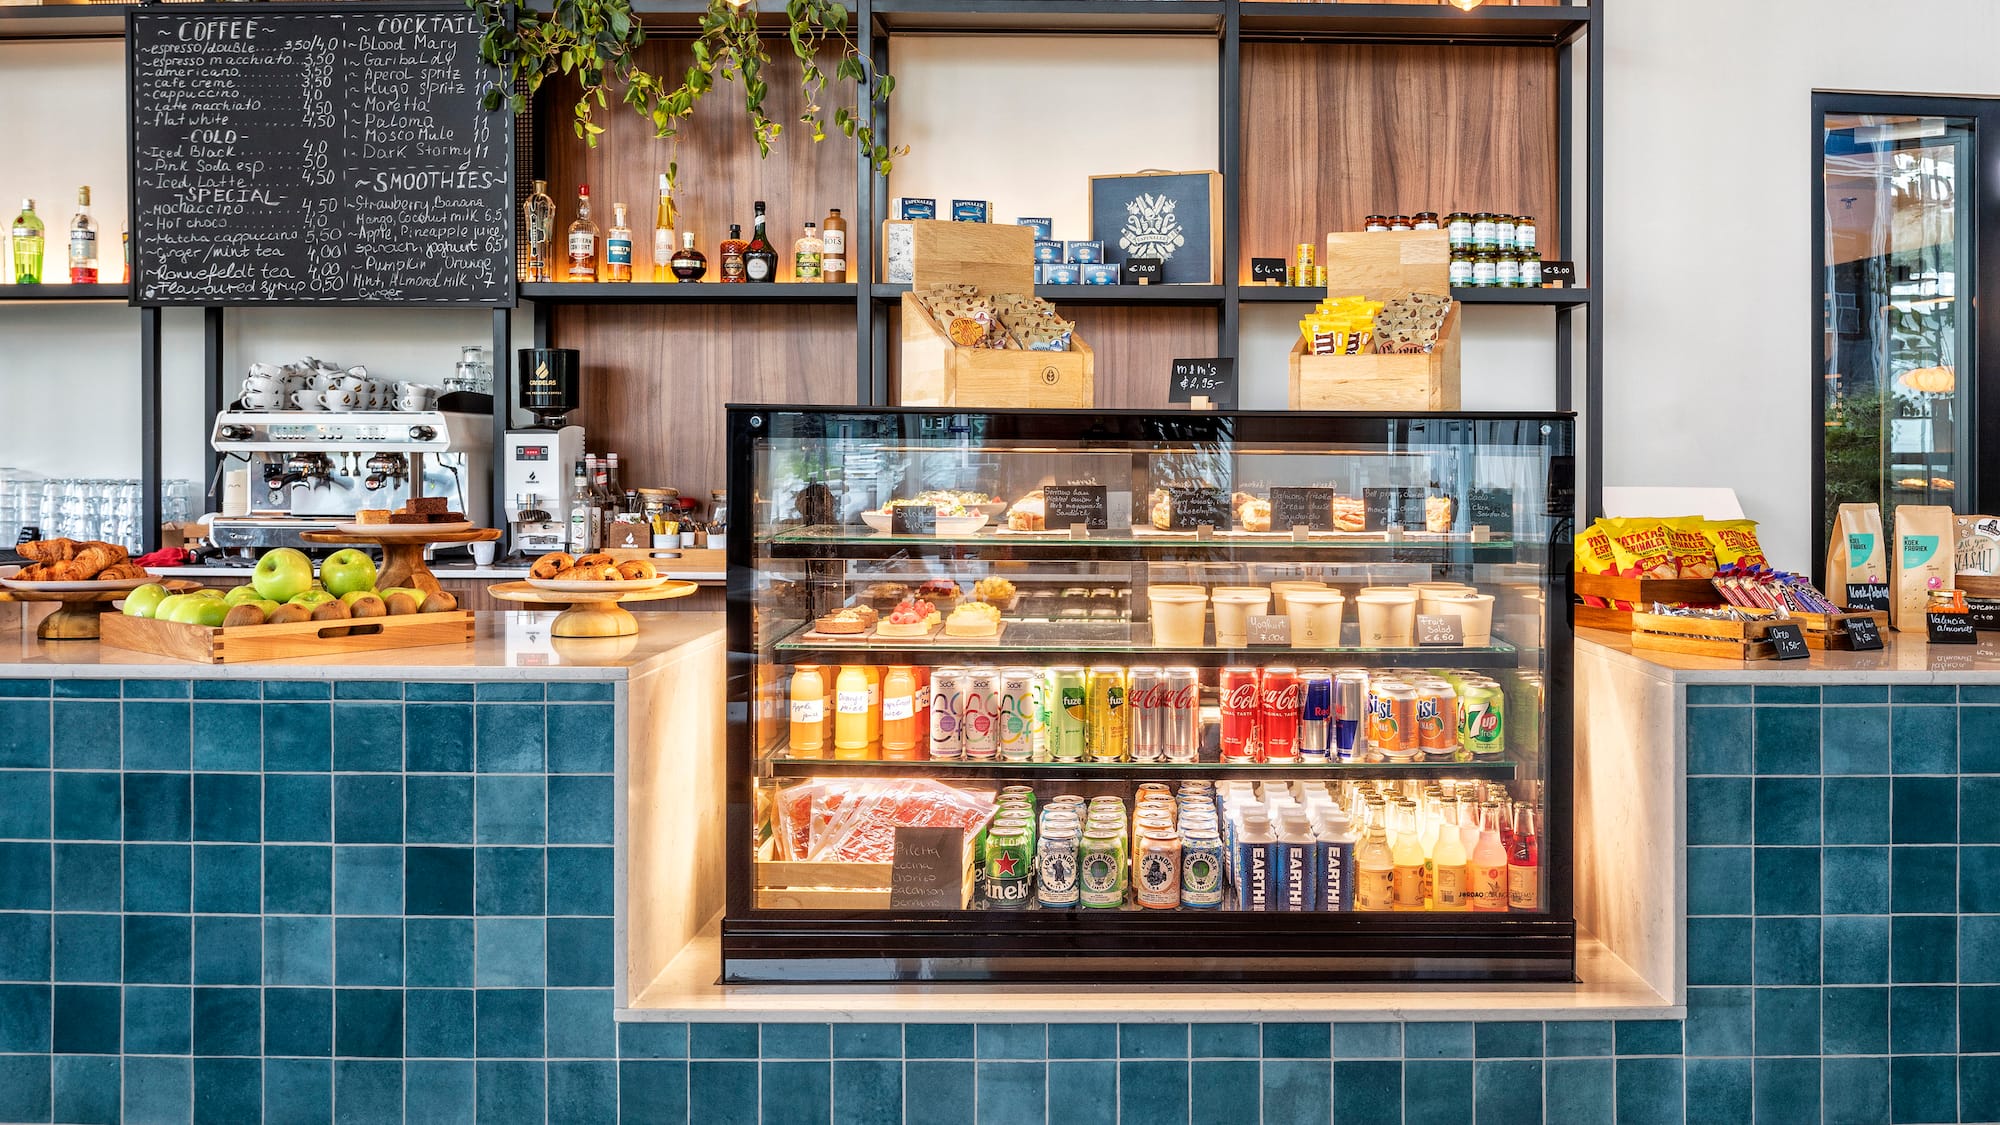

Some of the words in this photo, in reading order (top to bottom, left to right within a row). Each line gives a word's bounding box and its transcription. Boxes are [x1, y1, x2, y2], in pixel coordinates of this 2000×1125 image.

[179, 21, 258, 41] COFFEE
[151, 41, 254, 56] espresso/double
[283, 36, 338, 54] 3,50/4,0
[360, 35, 405, 51] Blood
[415, 35, 457, 61] Mary
[153, 57, 204, 68] espresso
[210, 54, 292, 65] macchiato
[304, 53, 335, 66] 3,50
[155, 68, 239, 77] americano
[302, 66, 332, 79] 3,50
[365, 68, 414, 84] Aperol
[421, 66, 461, 89] spritz
[475, 69, 487, 80] 11
[155, 79, 186, 88] cafe
[192, 79, 235, 87] creme
[302, 76, 331, 89] 3,50
[153, 90, 239, 104] cappuccino
[302, 90, 322, 104] 4,0
[365, 82, 408, 102] Hugo
[420, 82, 465, 102] spritz
[155, 100, 187, 111] Latte
[192, 99, 261, 111] macchiato
[303, 101, 332, 117] 4,50
[365, 97, 429, 111] Moretta
[153, 112, 185, 127] flat
[189, 113, 228, 125] white
[302, 114, 335, 128] 4,50
[365, 113, 434, 128] Paloma
[474, 115, 487, 129] 11
[191, 129, 237, 144] COLD
[418, 127, 453, 140] Mule
[474, 128, 489, 142] 10
[151, 147, 184, 157] Iced
[190, 145, 236, 157] Black
[302, 139, 327, 156] 4,0
[363, 144, 407, 158] Dark
[417, 143, 471, 170] Stormy
[475, 144, 488, 158] 11
[155, 160, 189, 171] Pink
[197, 159, 231, 171] Soda
[237, 161, 264, 180] esp
[302, 154, 327, 170] 5,0
[156, 174, 191, 189] Iced
[198, 175, 247, 187] Latte
[302, 169, 335, 184] 4,50
[374, 172, 492, 192] SMOOTHIES
[186, 187, 280, 206] SPECIAL
[302, 199, 337, 217] 4,50
[399, 211, 446, 223] Coconut
[451, 210, 478, 221] milk
[485, 209, 501, 223] 6,5
[186, 218, 227, 228] choco
[304, 215, 327, 228] 4,0
[158, 233, 209, 244] Matcha
[214, 231, 298, 245] cappuccino
[305, 228, 341, 244] 5,50
[401, 225, 468, 239] Pineapple
[256, 245, 284, 257] tea
[308, 245, 341, 263] 4,00
[426, 239, 478, 258] yoghurt
[485, 237, 501, 253] 6,5
[366, 256, 425, 271] Pumpkin
[158, 262, 255, 285] Ronnefeldt
[261, 263, 295, 279] tea
[308, 263, 340, 280] 4,00
[390, 271, 441, 286] Almond
[484, 273, 495, 288] 7
[158, 280, 255, 294] Flavoured
[260, 279, 305, 298] syrup
[310, 277, 343, 294] 0,50
[359, 288, 402, 298] Ginger
[1250, 616, 1286, 636] Yoghurt
[1421, 616, 1445, 625] Fruit
[1930, 614, 1966, 625] Valencia
[1937, 625, 1973, 633] almonds
[1064, 697, 1082, 705] fuze
[1044, 854, 1075, 870] LOWLANDER
[1084, 853, 1116, 871] LOWLANDER
[1141, 854, 1172, 872] LOWLANDER
[1184, 853, 1217, 871] LOWLANDER
[1253, 848, 1265, 904] EARTH
[1290, 848, 1302, 904] EARTH
[1328, 847, 1340, 904] EARTH
